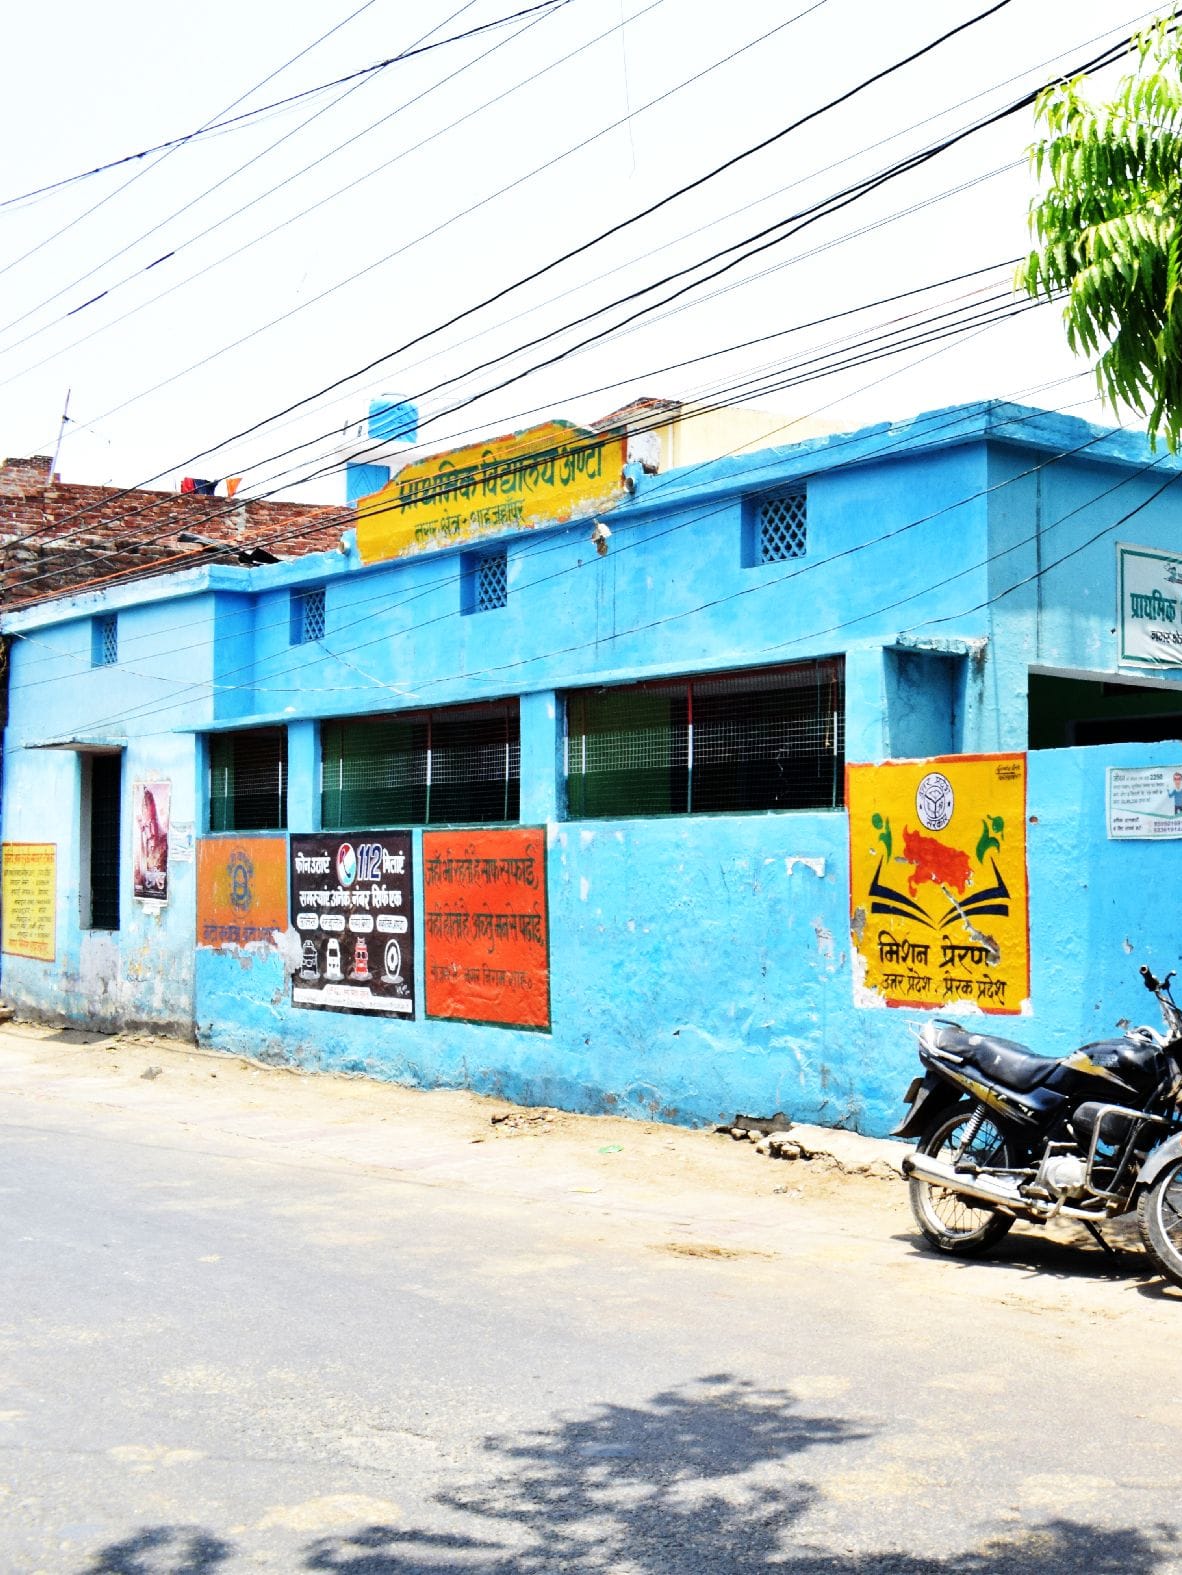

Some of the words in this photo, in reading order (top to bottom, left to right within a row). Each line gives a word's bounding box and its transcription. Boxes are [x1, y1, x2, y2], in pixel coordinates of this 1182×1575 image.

[480, 449, 558, 498] विद्यालय
[1130, 589, 1177, 623] प्राथमिक
[294, 851, 311, 874] फोन
[357, 843, 383, 881] 112
[878, 929, 930, 968] मिशन
[938, 934, 991, 975] प्रेरण
[882, 973, 906, 997] उत्तर
[942, 970, 973, 1000] प्रेरक
[976, 973, 1007, 1006] प्रदेश
